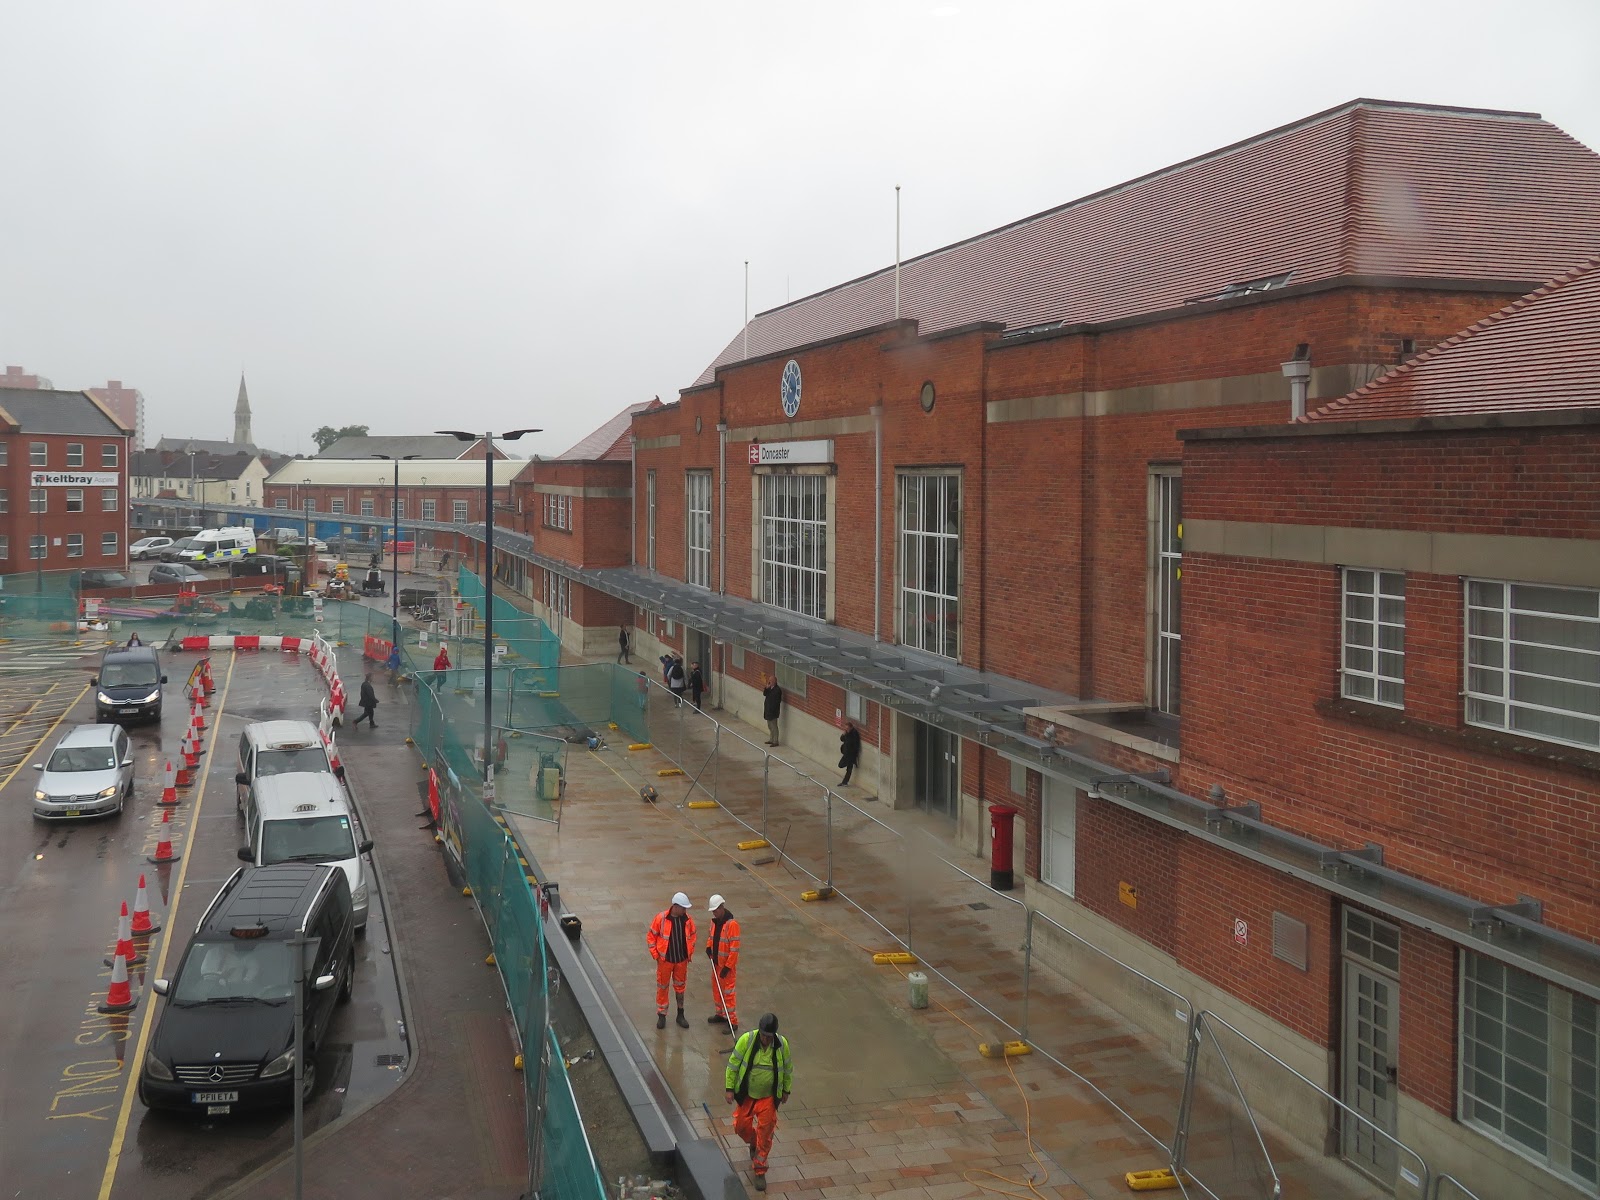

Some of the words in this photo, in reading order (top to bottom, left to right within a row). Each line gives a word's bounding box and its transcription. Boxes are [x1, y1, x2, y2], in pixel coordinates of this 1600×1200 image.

[761, 447, 790, 460] Doncaster
[46, 474, 93, 485] keltbray
[45, 1059, 124, 1121] ONLY
[217, 1092, 234, 1101] ETA
